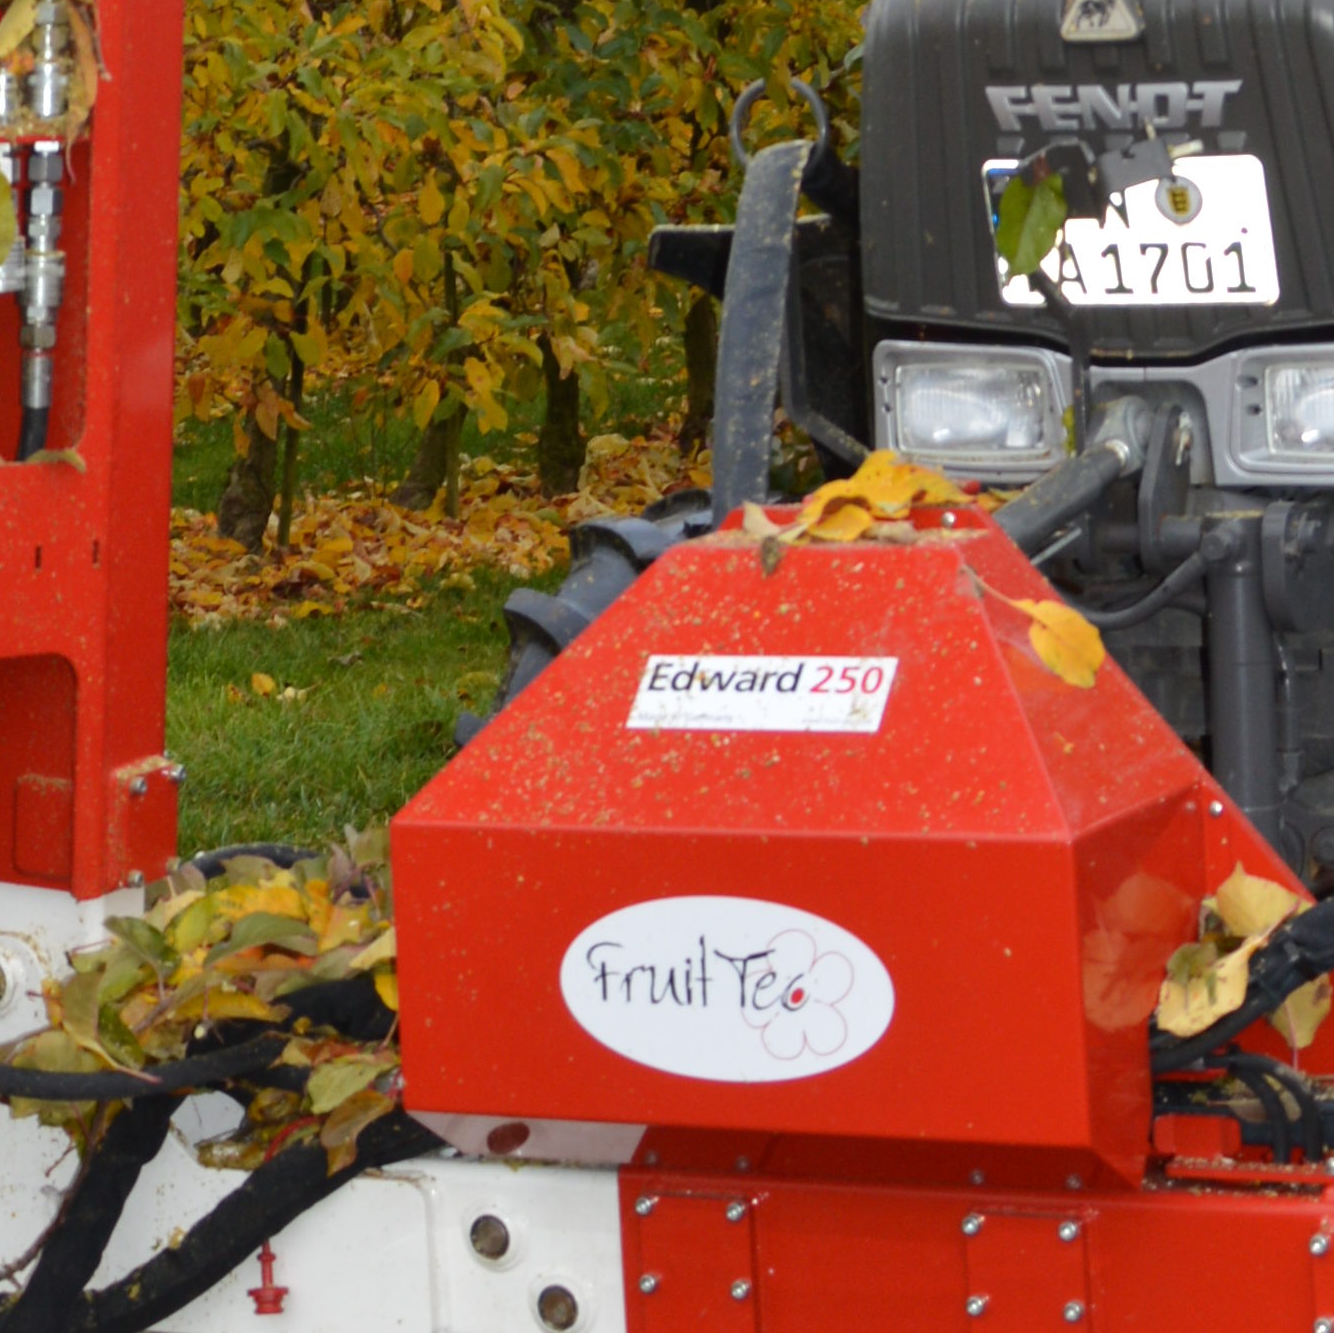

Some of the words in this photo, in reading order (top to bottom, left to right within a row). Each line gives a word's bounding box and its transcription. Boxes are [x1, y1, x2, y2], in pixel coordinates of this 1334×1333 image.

[985, 79, 1244, 131] FENDT
[646, 661, 805, 693] Edward
[808, 665, 884, 695] 250
